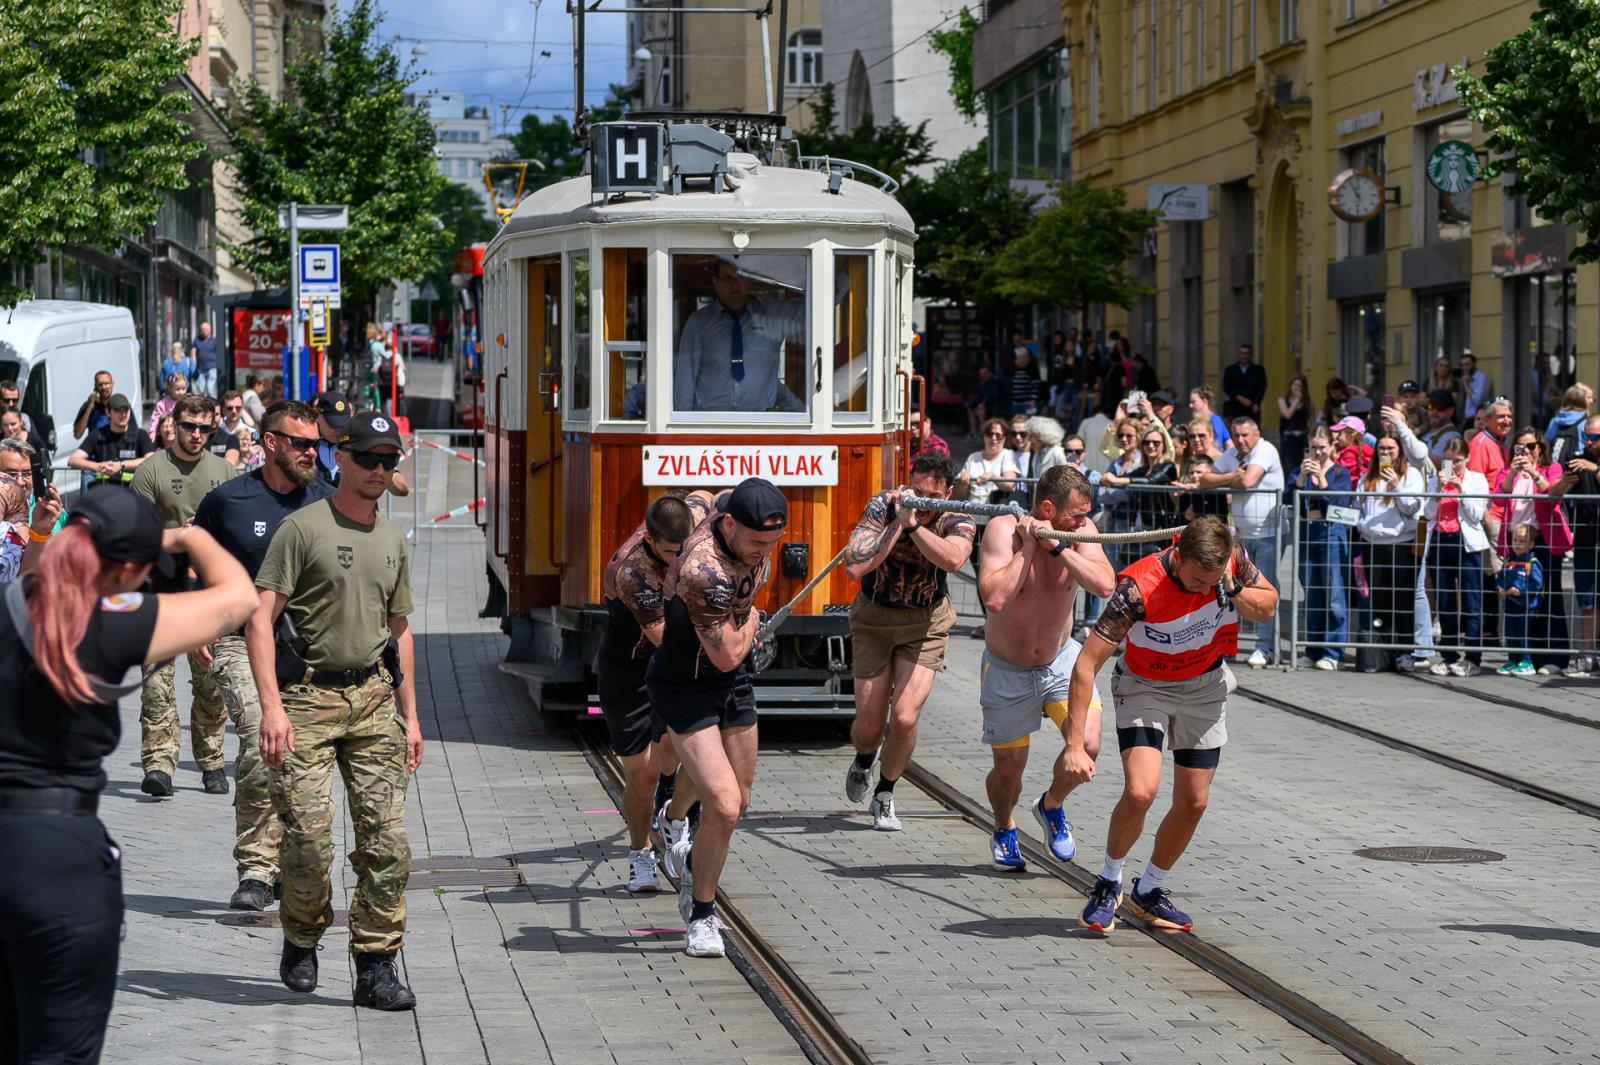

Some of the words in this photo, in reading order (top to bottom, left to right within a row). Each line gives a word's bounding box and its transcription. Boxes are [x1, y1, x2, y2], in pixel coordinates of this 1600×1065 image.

[616, 137, 647, 179] H
[249, 334, 271, 349] 20
[657, 449, 761, 476] ZVLÁŠTNÍ
[768, 455, 823, 476] VLAK
